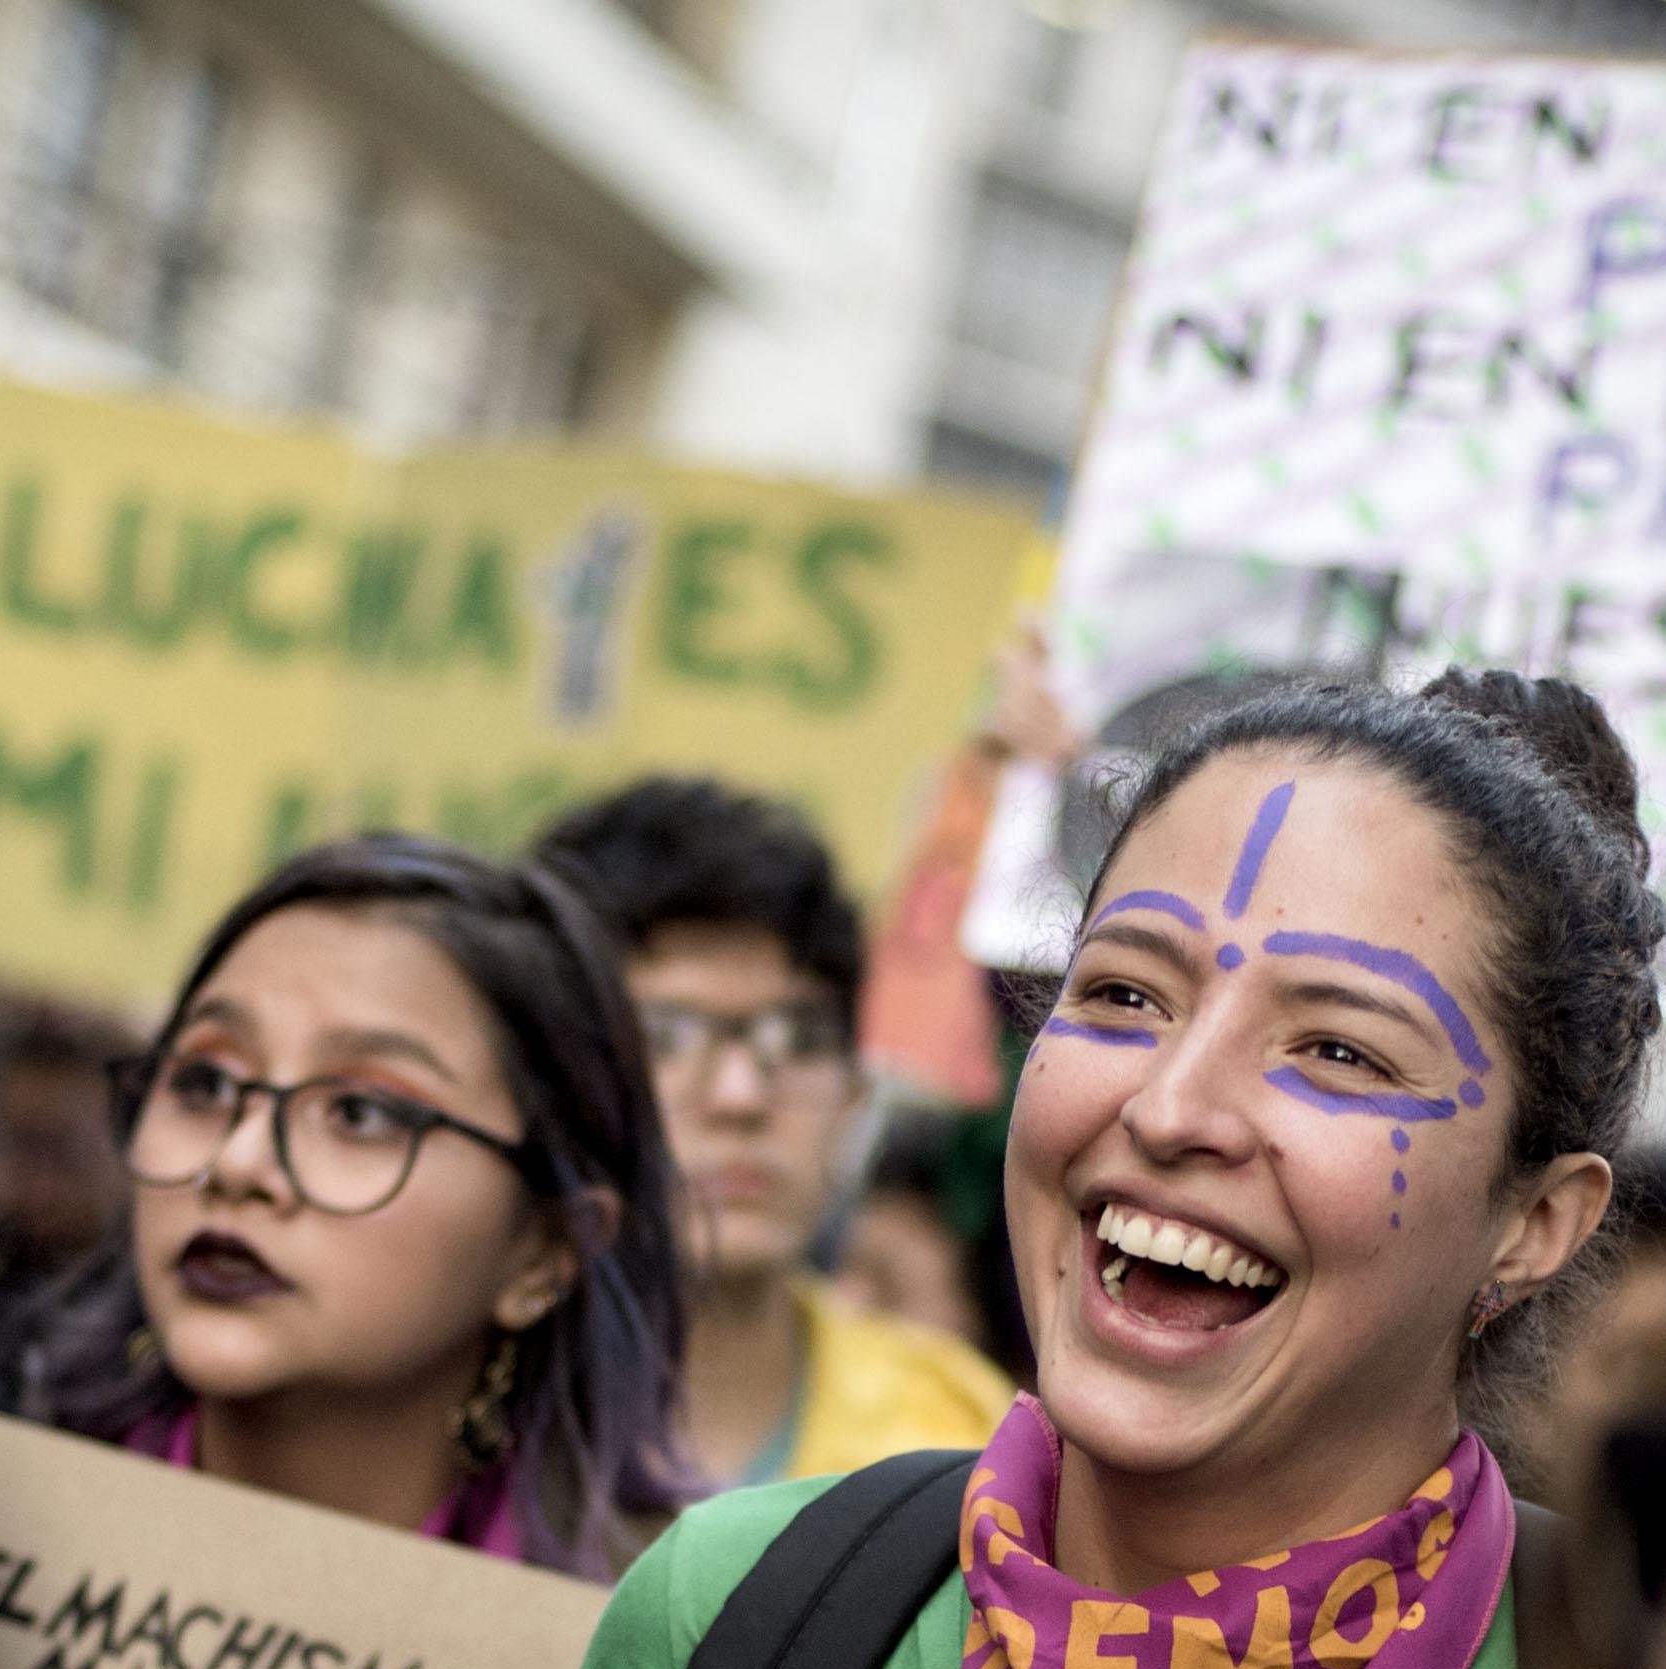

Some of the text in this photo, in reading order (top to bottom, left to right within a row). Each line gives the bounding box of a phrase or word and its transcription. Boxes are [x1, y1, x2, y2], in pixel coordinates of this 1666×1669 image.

[1199, 74, 1353, 175] NI
[1421, 90, 1615, 178] EN
[1149, 308, 1327, 388] NI
[1383, 312, 1595, 420] EN
[651, 512, 897, 714] ES
